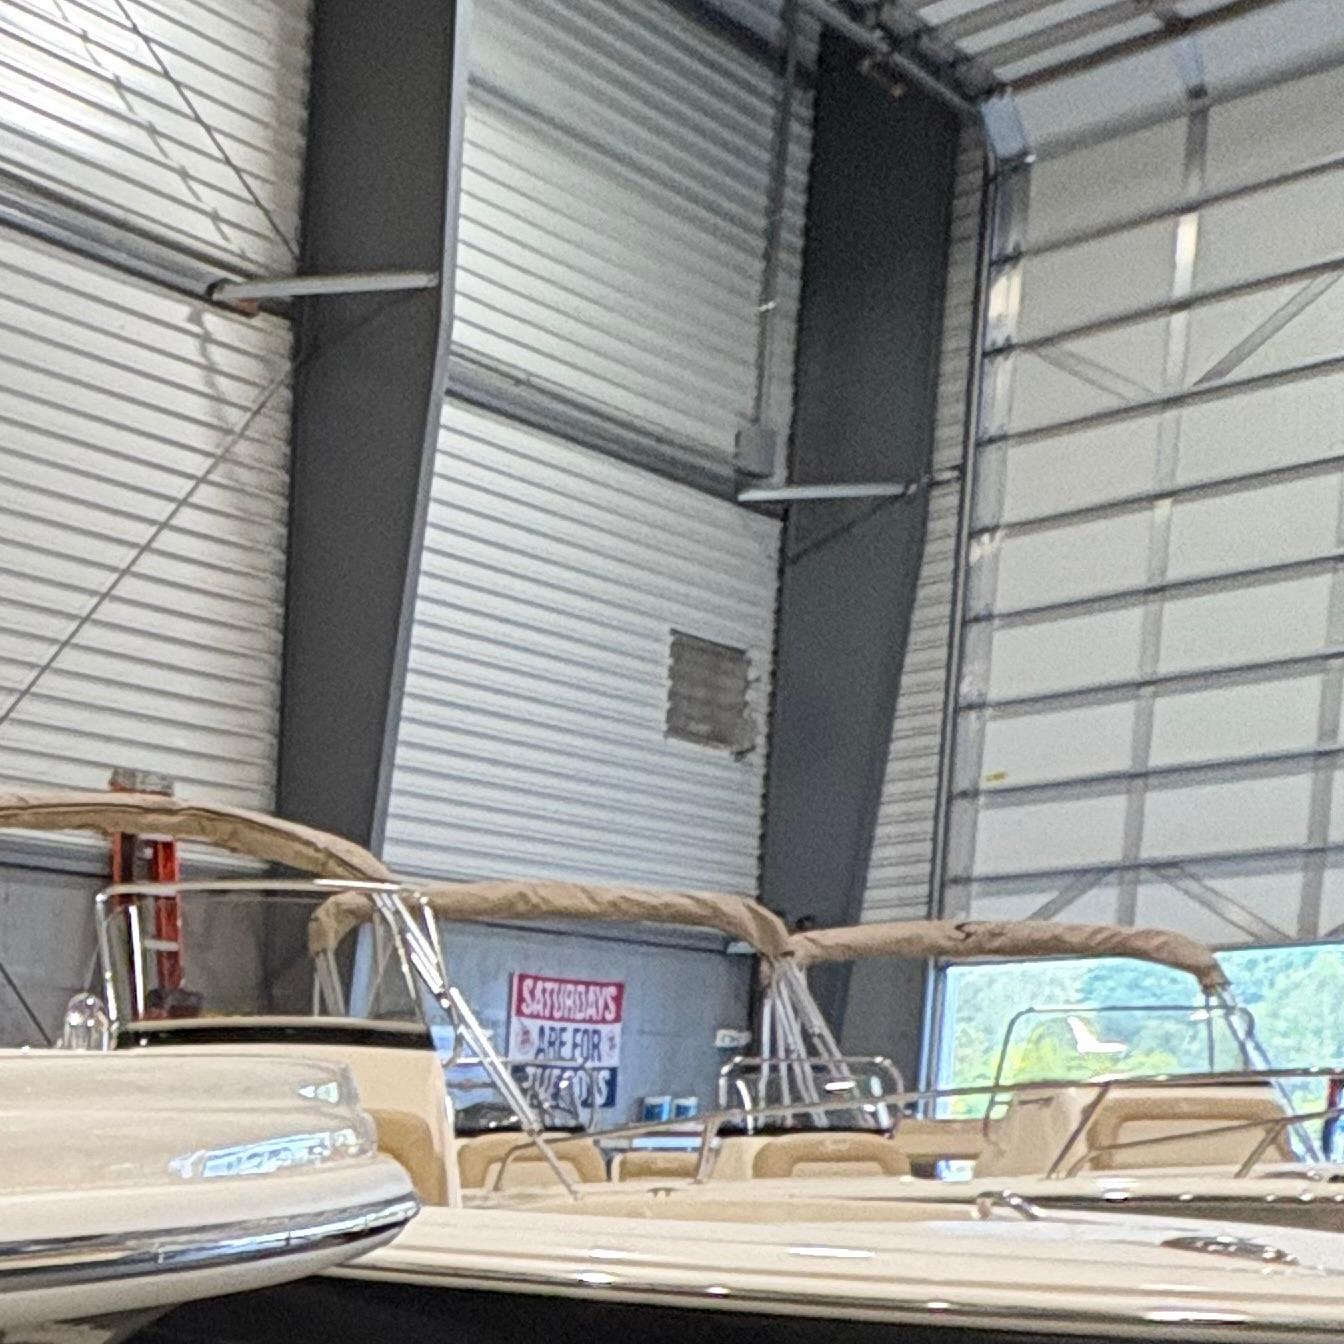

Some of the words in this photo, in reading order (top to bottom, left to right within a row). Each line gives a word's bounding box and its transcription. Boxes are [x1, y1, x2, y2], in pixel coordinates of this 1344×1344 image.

[520, 978, 618, 1022] SATURDAYS
[534, 1025, 568, 1060] ARE
[572, 1028, 602, 1063] FOR
